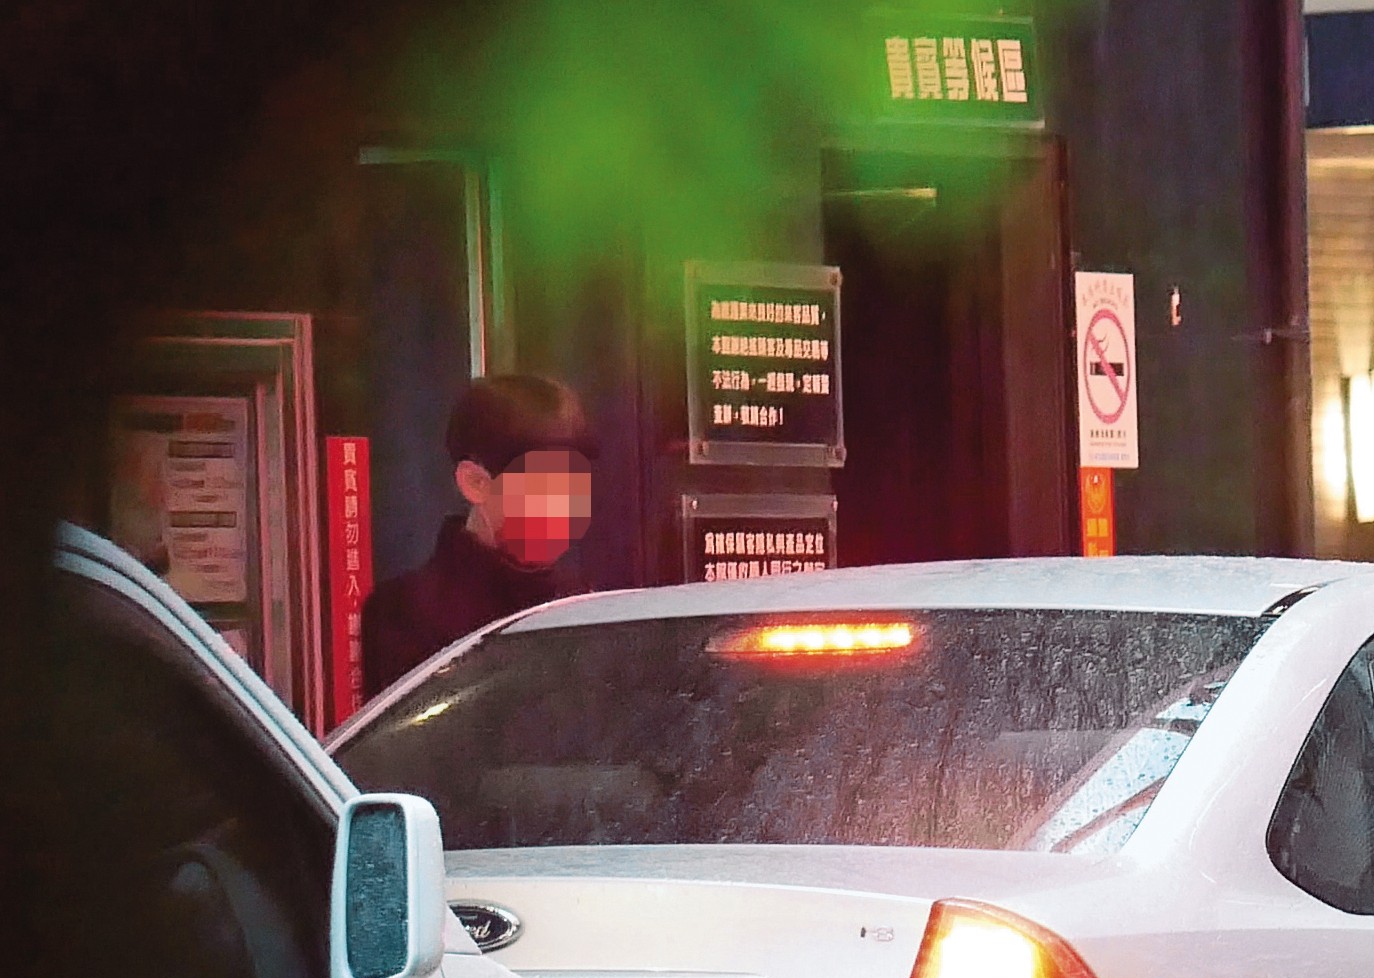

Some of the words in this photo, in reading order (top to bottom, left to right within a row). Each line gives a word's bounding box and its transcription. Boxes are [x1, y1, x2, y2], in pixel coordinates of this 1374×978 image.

[885, 36, 1028, 103] 貴賓等候區
